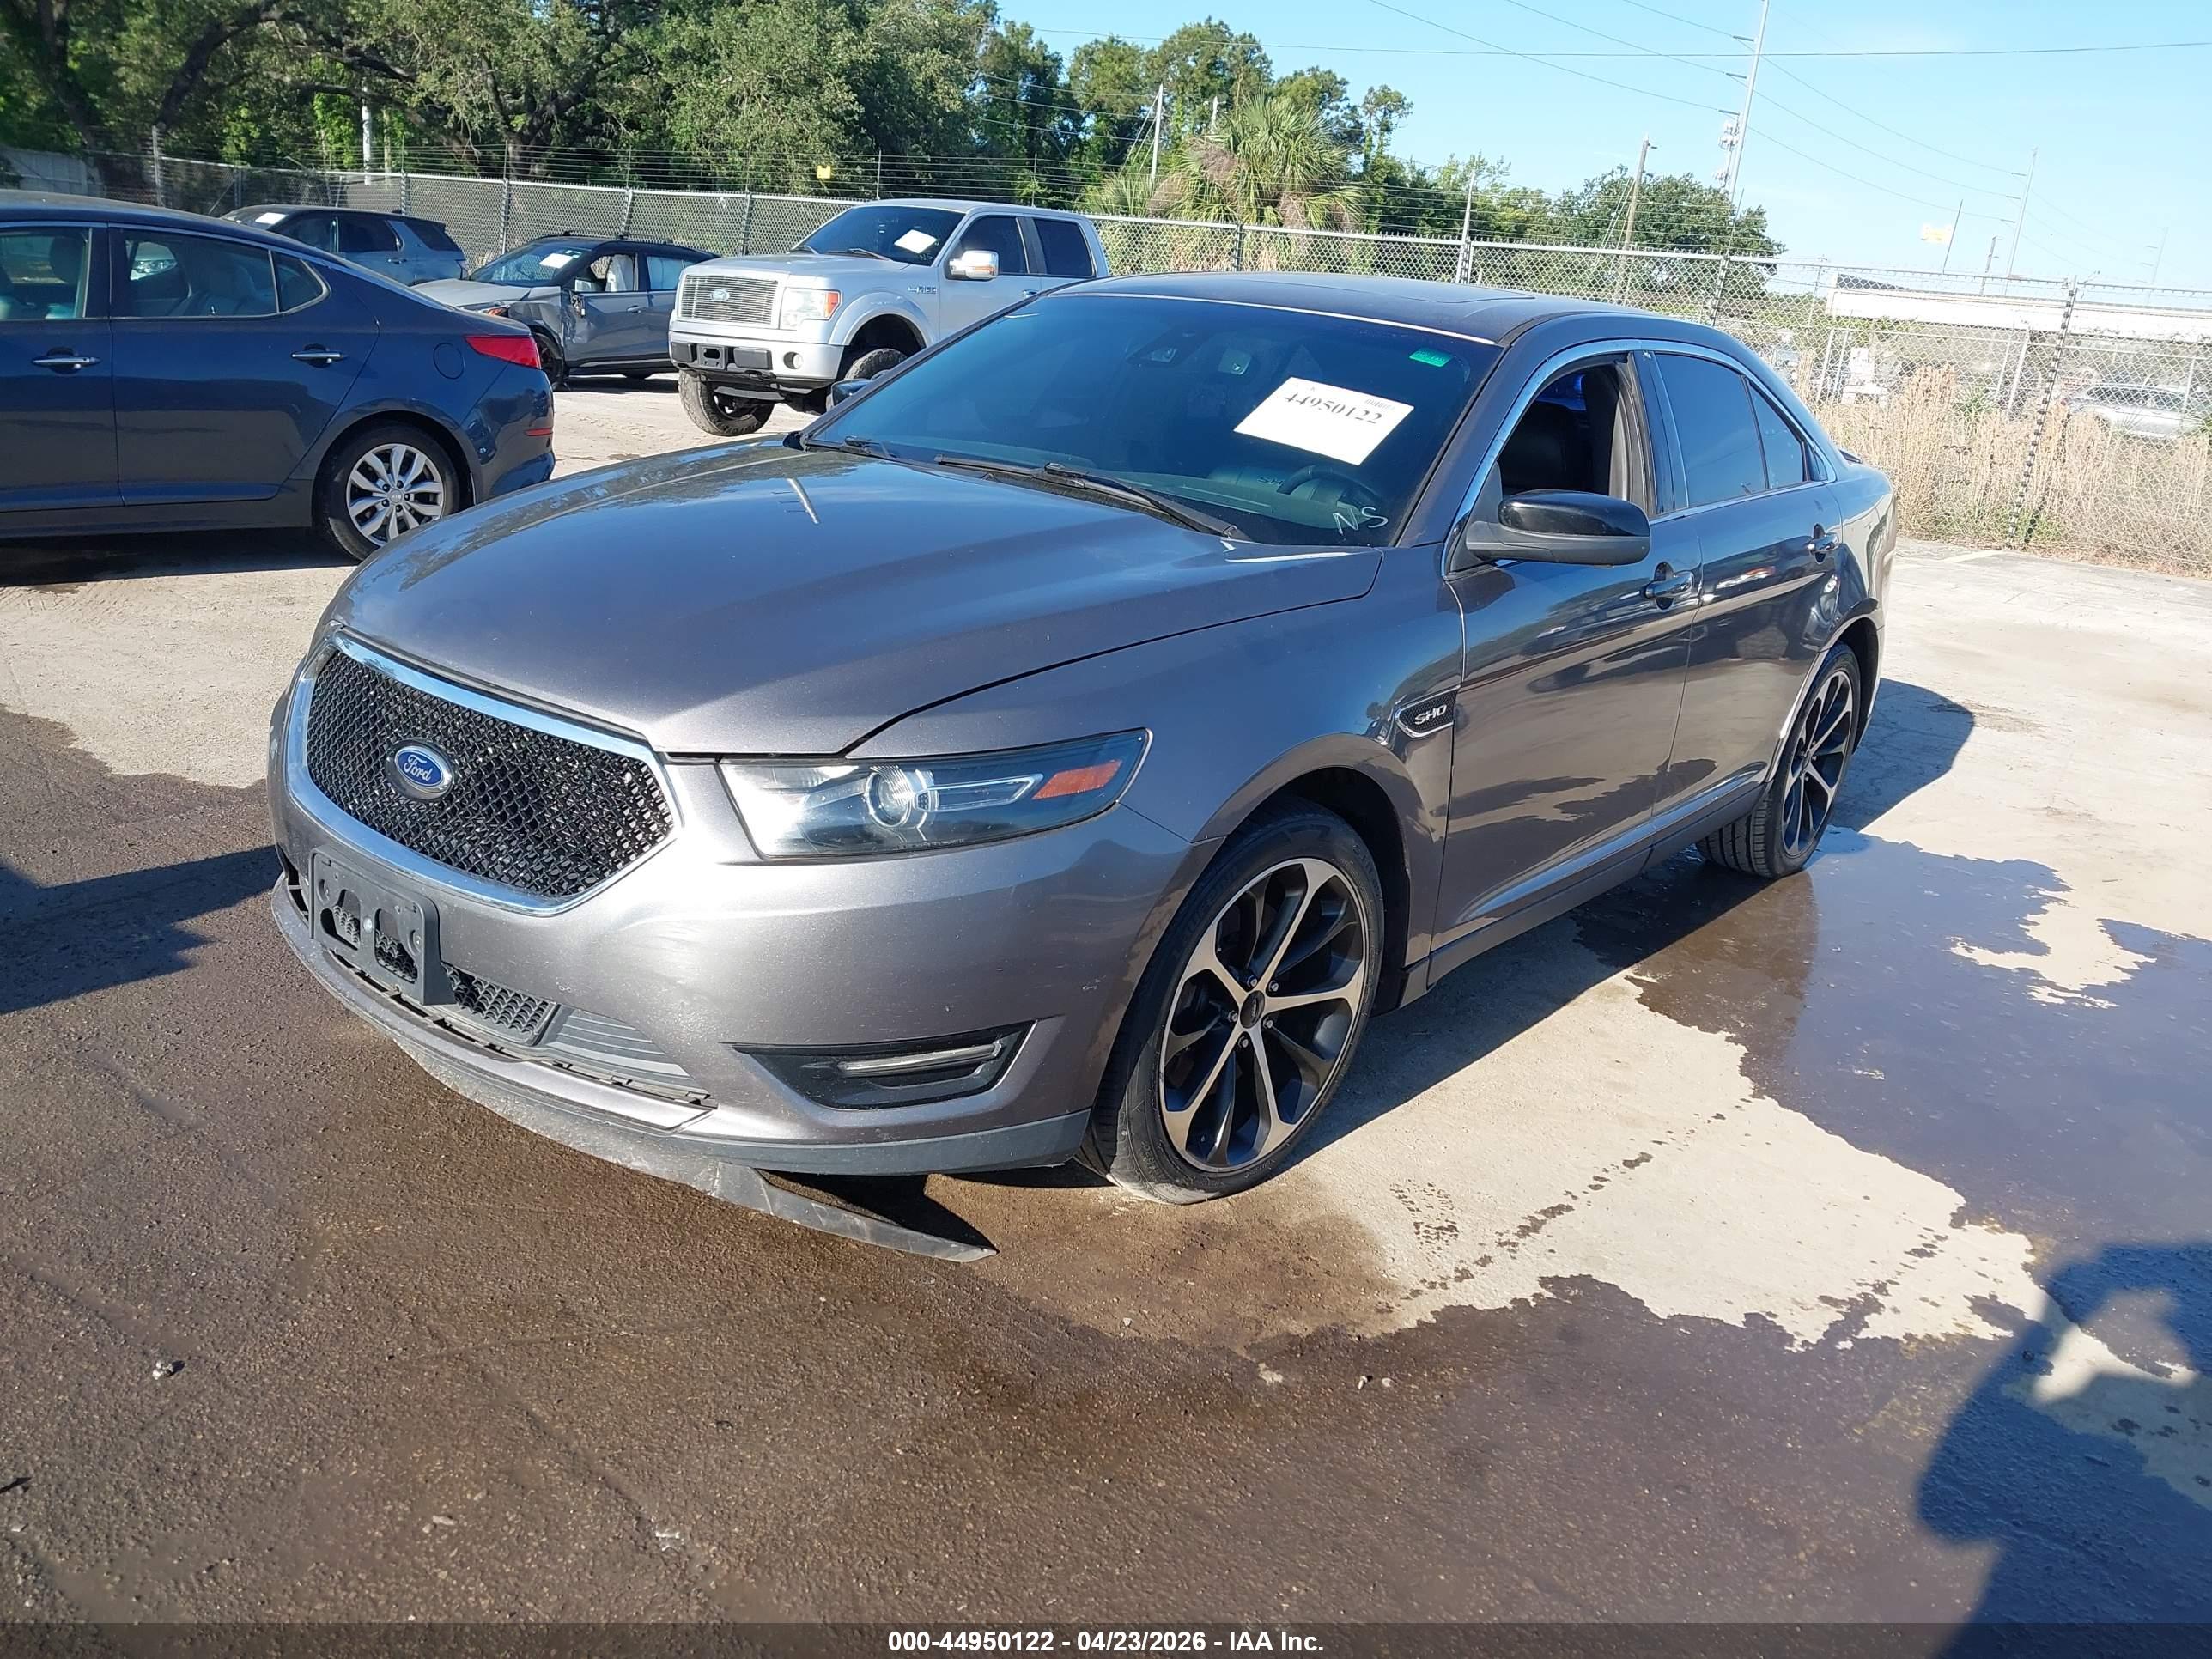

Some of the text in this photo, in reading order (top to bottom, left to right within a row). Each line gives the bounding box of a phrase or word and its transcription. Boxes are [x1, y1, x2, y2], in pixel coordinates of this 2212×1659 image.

[1284, 392, 1382, 424] 44950122
[1257, 476, 1284, 488] SH
[1333, 507, 1389, 536] NS
[1414, 704, 1447, 725] SHO
[404, 754, 434, 781] Ford
